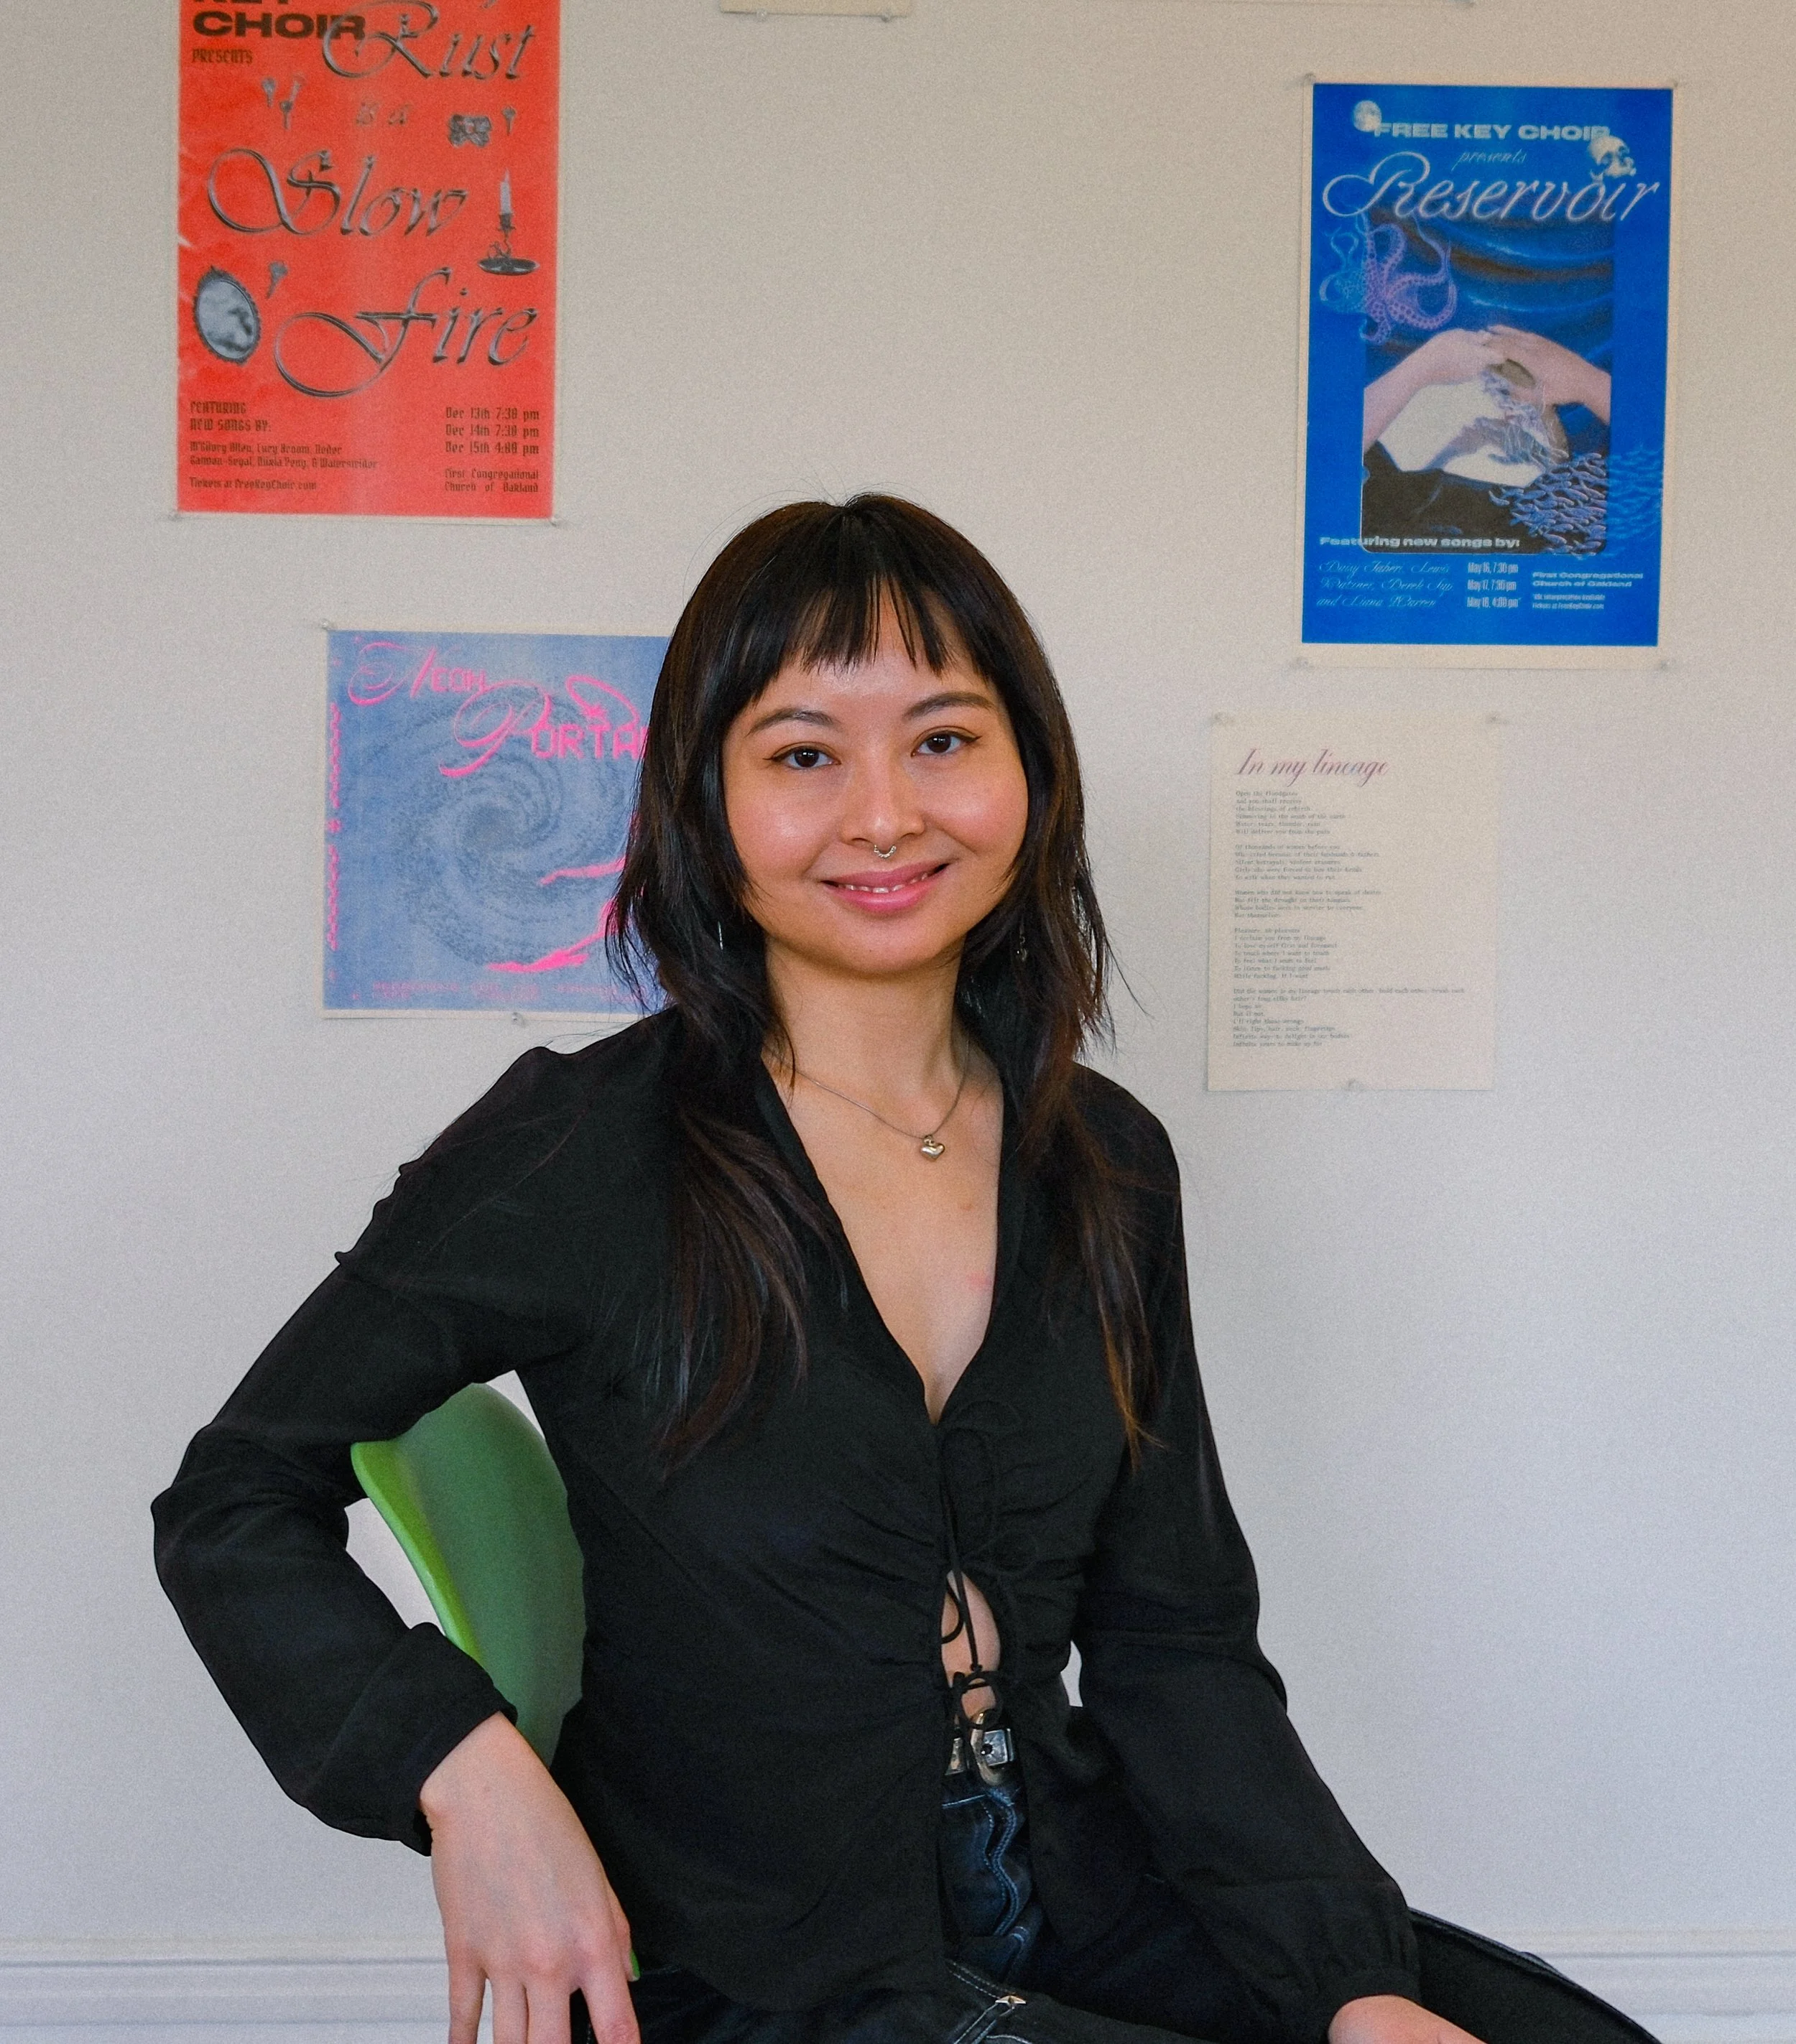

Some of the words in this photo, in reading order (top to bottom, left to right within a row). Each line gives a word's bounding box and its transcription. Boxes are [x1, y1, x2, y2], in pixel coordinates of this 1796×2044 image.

[193, 11, 366, 41] CHOIR
[322, 0, 537, 79] Rust
[192, 48, 253, 64] PRESENTS
[1374, 123, 1448, 139] FREE
[1454, 124, 1512, 139] KEY
[1451, 148, 1527, 172] presents
[207, 148, 468, 238] Slow
[1322, 149, 1660, 222] Reservoir
[190, 401, 246, 414] FEATURING
[445, 407, 464, 418] Dec
[471, 407, 490, 419] 13th
[496, 407, 518, 419] 7:30
[522, 409, 540, 422] pm
[218, 419, 251, 432] SONGS
[445, 424, 464, 436] Dec
[471, 424, 490, 437] 14th
[496, 424, 518, 437] 7:30
[522, 427, 540, 439] pm
[445, 441, 464, 453] Dec
[471, 441, 490, 454] 15th
[496, 441, 518, 455] 4:00
[522, 444, 540, 456] pm
[485, 482, 495, 492] of
[1320, 536, 1400, 549] Featuring
[1402, 538, 1438, 547] new
[1440, 538, 1492, 549] songs
[1494, 537, 1521, 549] by:
[1468, 562, 1481, 574] May
[1467, 579, 1481, 591] May
[1316, 595, 1343, 608] and
[1467, 596, 1481, 608] May
[1237, 748, 1264, 775] In
[1270, 760, 1307, 787] my
[1313, 748, 1391, 787] lineage
